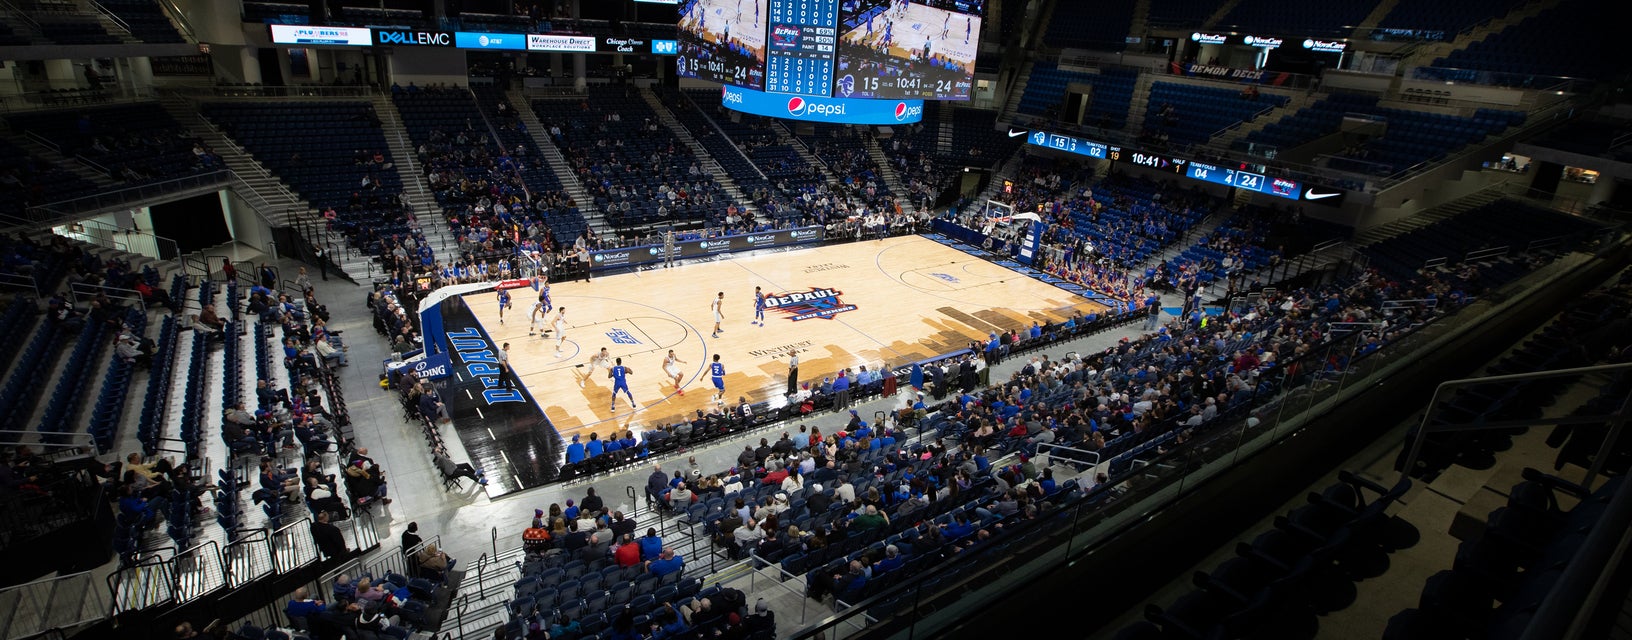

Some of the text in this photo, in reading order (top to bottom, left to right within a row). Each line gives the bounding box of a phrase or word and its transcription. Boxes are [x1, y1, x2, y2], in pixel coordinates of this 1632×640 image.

[532, 36, 567, 44] WAREHOUSE
[690, 59, 698, 70] 15
[708, 62, 724, 73] 10:41
[735, 66, 746, 80] 24
[1190, 64, 1264, 80] DEMON DECK
[864, 77, 878, 90] 15
[897, 78, 920, 88] 10:41
[936, 80, 952, 92] 24
[808, 103, 845, 116] pepsi
[1055, 138, 1065, 148] 15
[1090, 148, 1119, 160] 02 19
[1132, 153, 1158, 167] 10:41
[1195, 169, 1207, 178] 04
[1225, 175, 1232, 184] 4
[1241, 176, 1256, 187] 24
[764, 290, 839, 308] DEPAUL
[796, 306, 854, 320] BLUE DEMONS
[748, 340, 811, 356] WINTRUST
[415, 364, 446, 378] LDING
